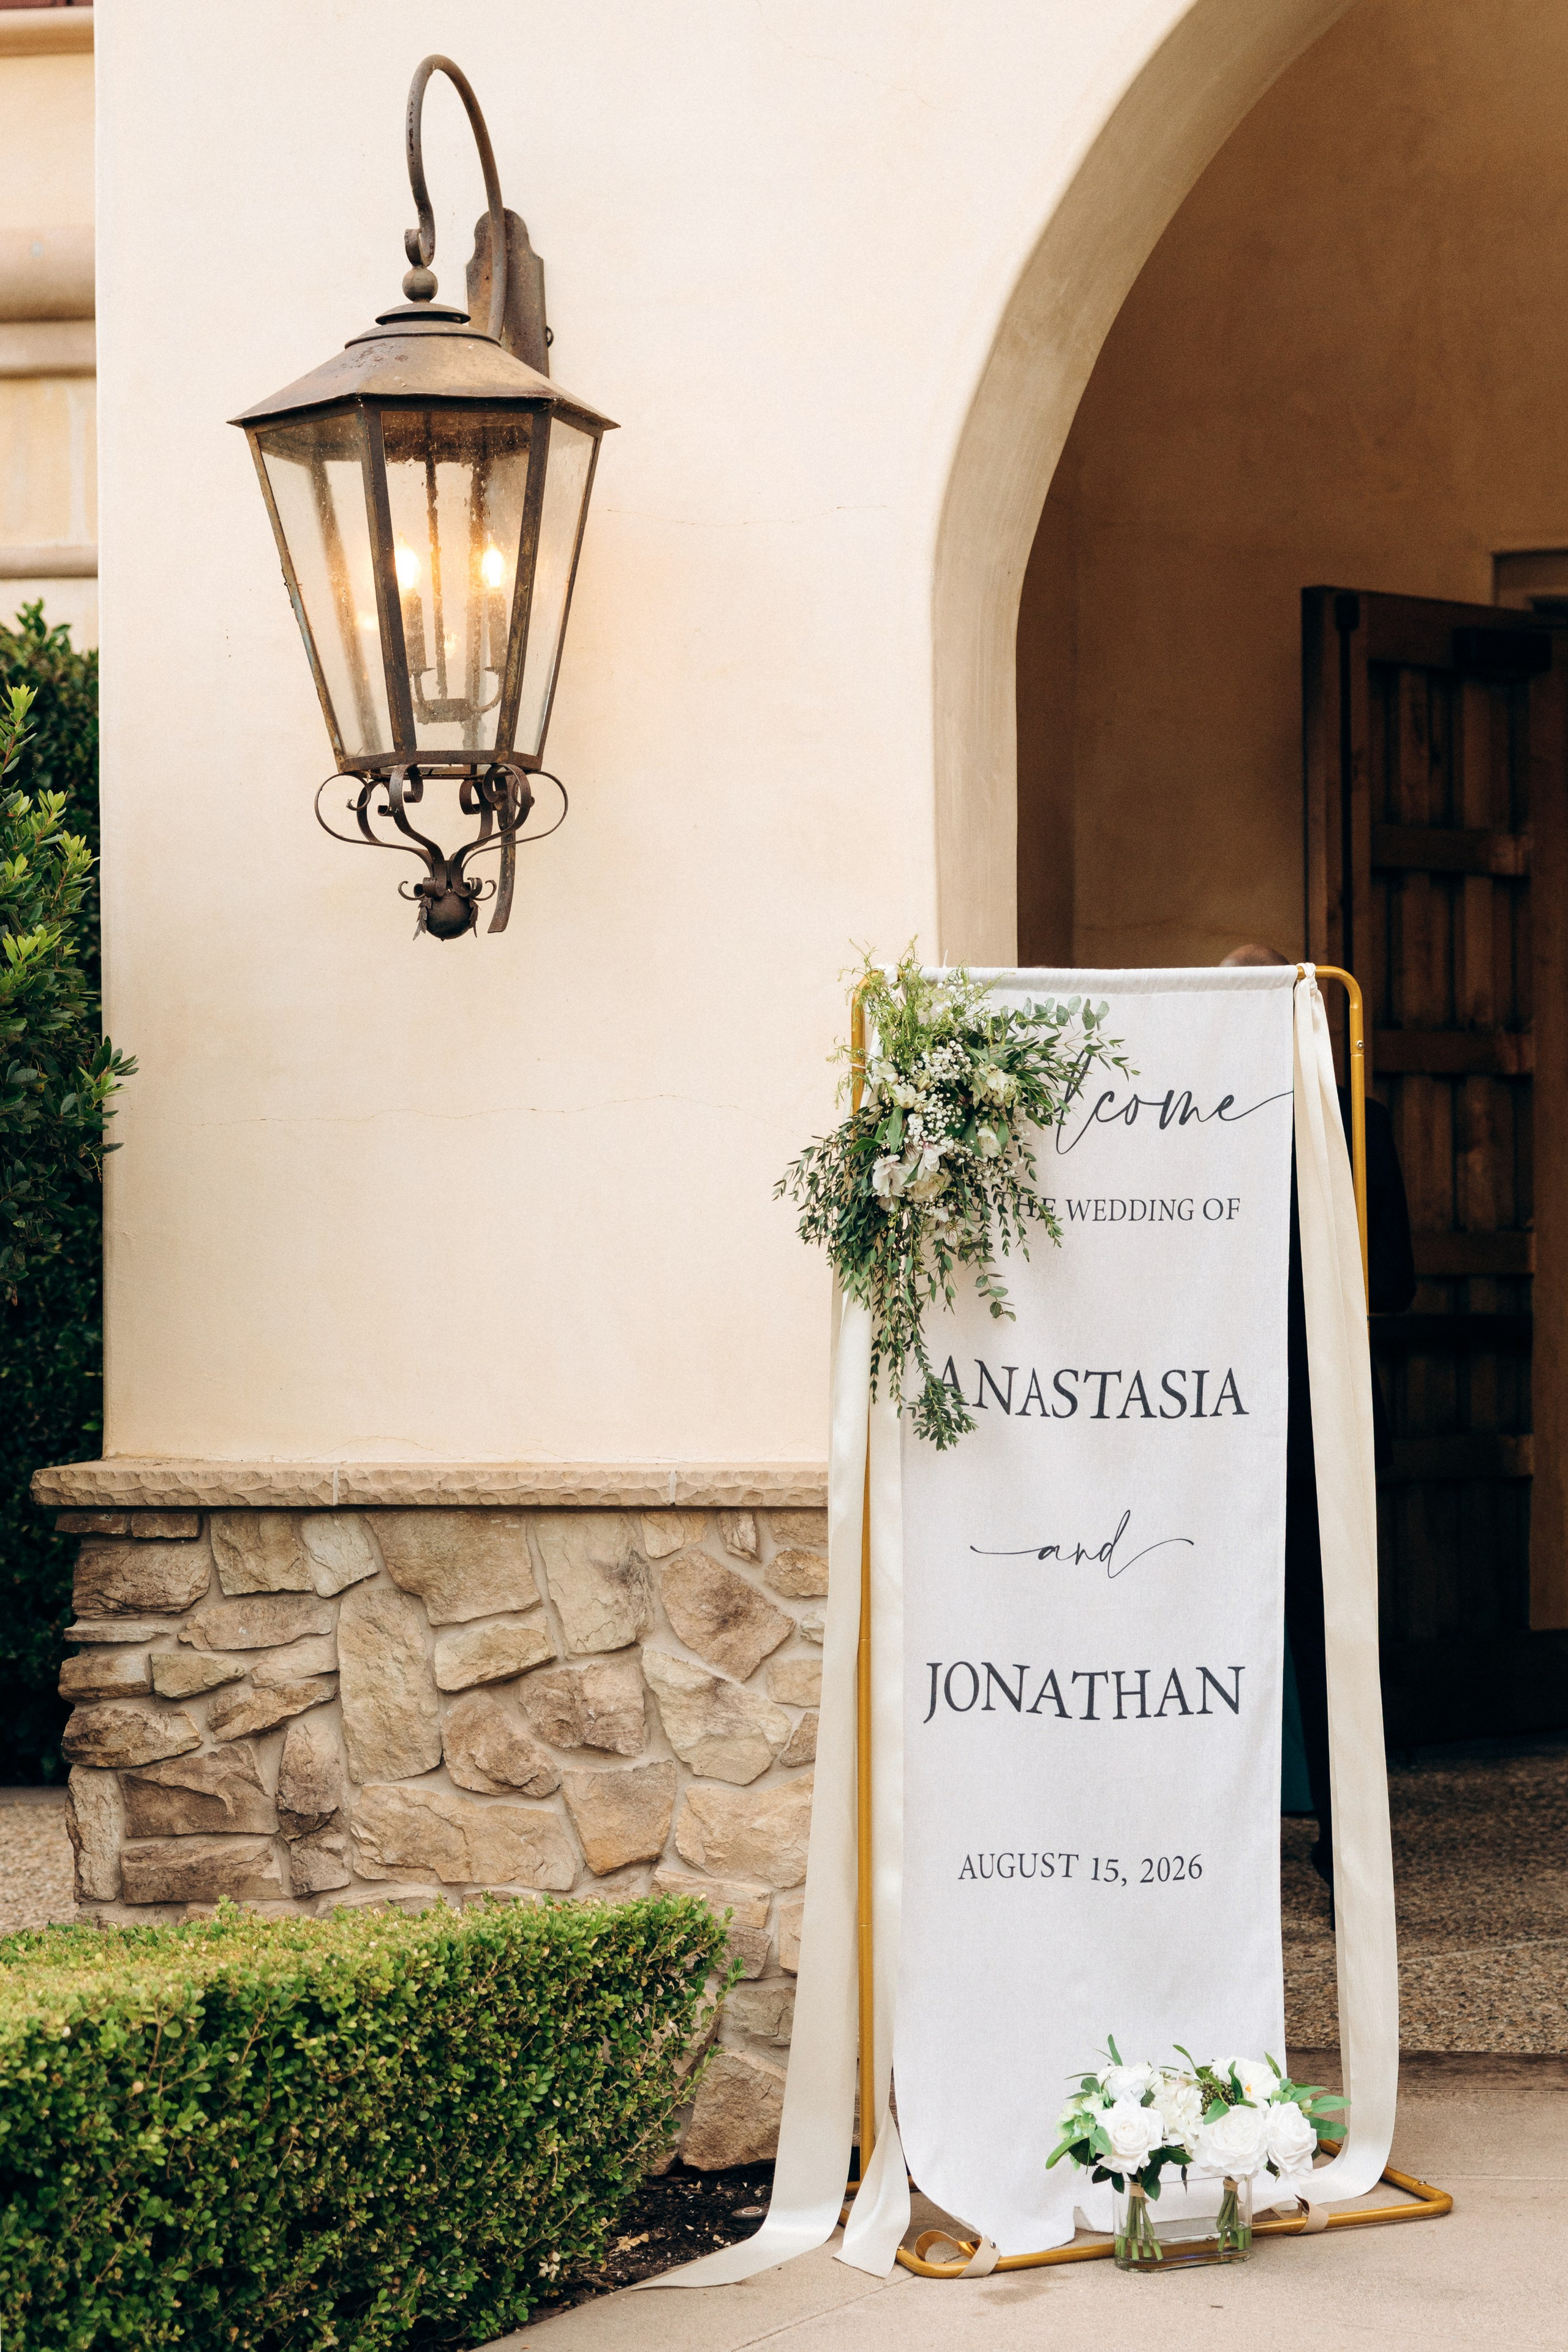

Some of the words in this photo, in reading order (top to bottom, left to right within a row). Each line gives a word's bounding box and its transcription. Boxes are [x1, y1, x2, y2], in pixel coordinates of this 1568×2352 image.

[1054, 1044, 1293, 1155] lcome
[1066, 1199, 1194, 1221] WEDDING
[1203, 1198, 1240, 1220] OF
[940, 1355, 1250, 1419] ANASTASIA
[970, 1510, 1194, 1578] and
[924, 1661, 1245, 1724] JONATHAN
[958, 1852, 1079, 1879] AUGUST
[1091, 1857, 1128, 1887] 15,
[1140, 1853, 1202, 1883] 2026
